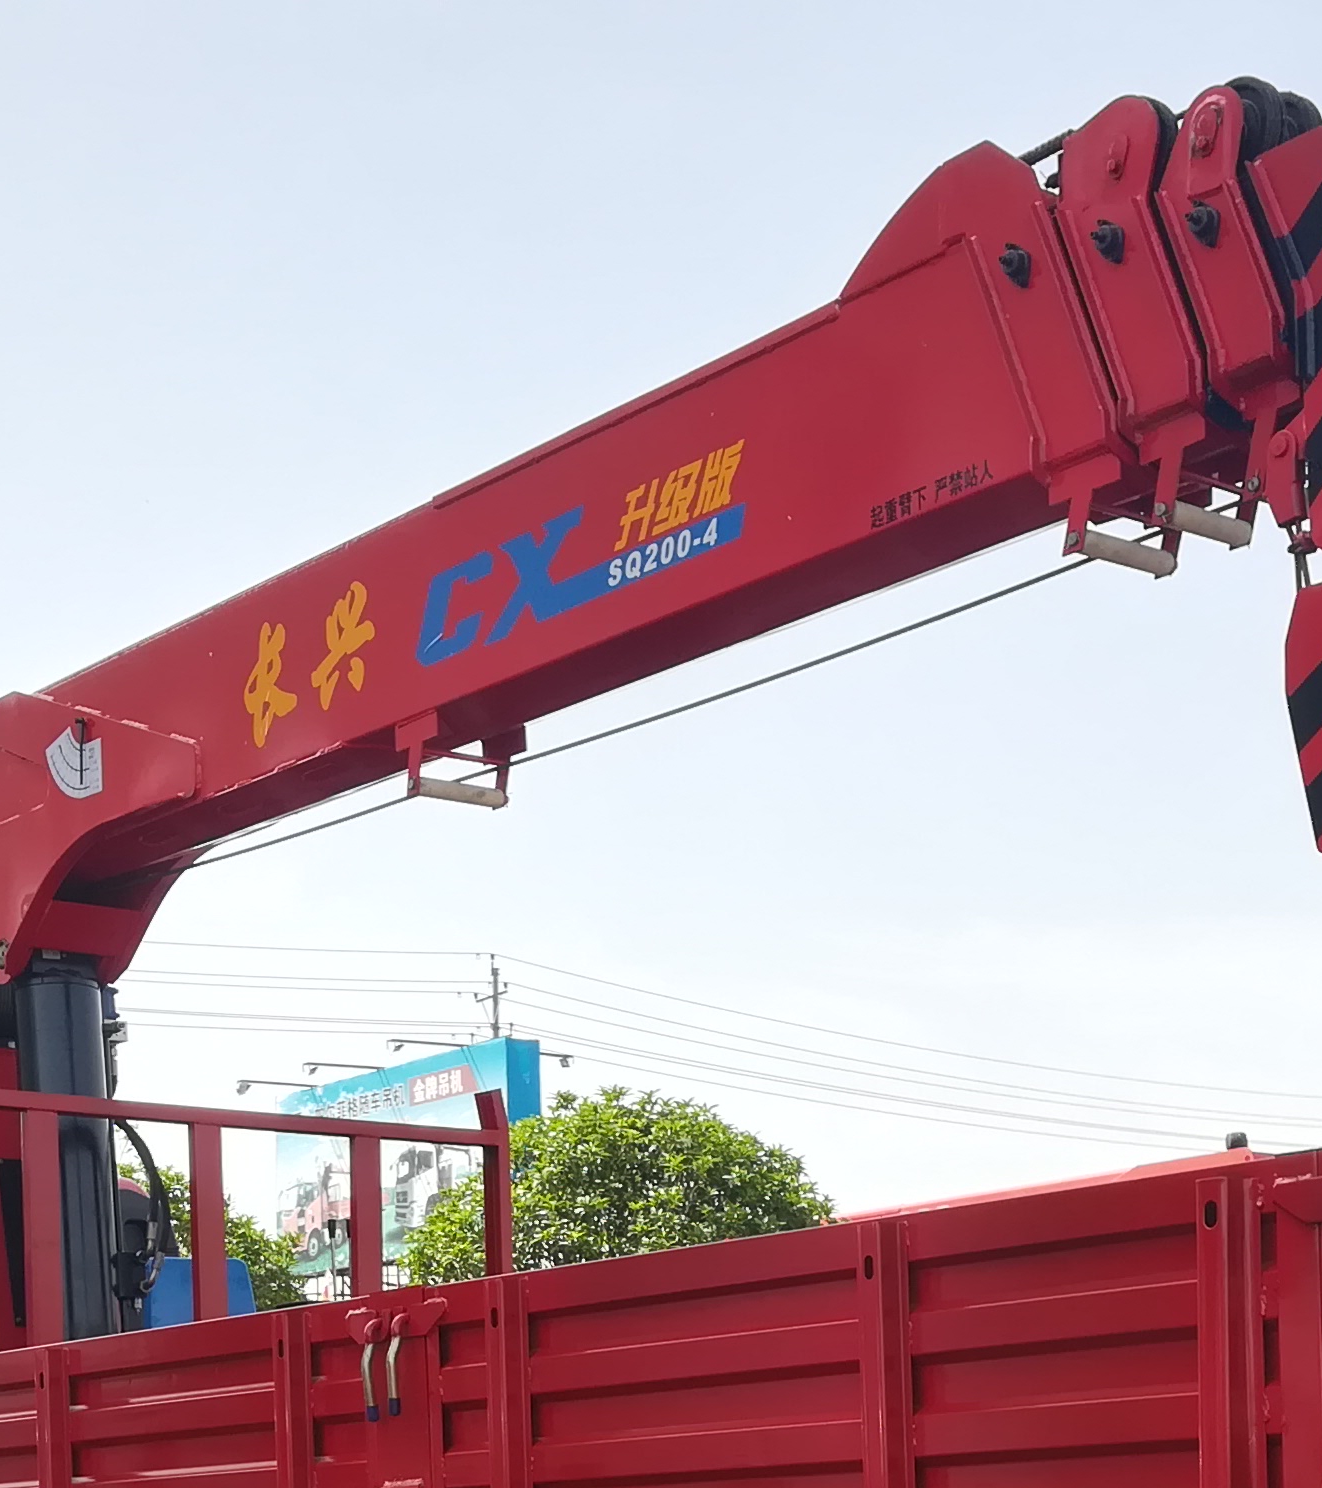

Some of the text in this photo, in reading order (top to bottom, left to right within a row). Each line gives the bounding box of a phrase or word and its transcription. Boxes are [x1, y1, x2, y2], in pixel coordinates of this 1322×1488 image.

[614, 439, 745, 551] 升级版
[870, 460, 994, 530] 起重臂下 严禁站人
[415, 504, 585, 667] CX
[608, 518, 718, 587] SQ200-4
[413, 1069, 464, 1104] 金牌吊机
